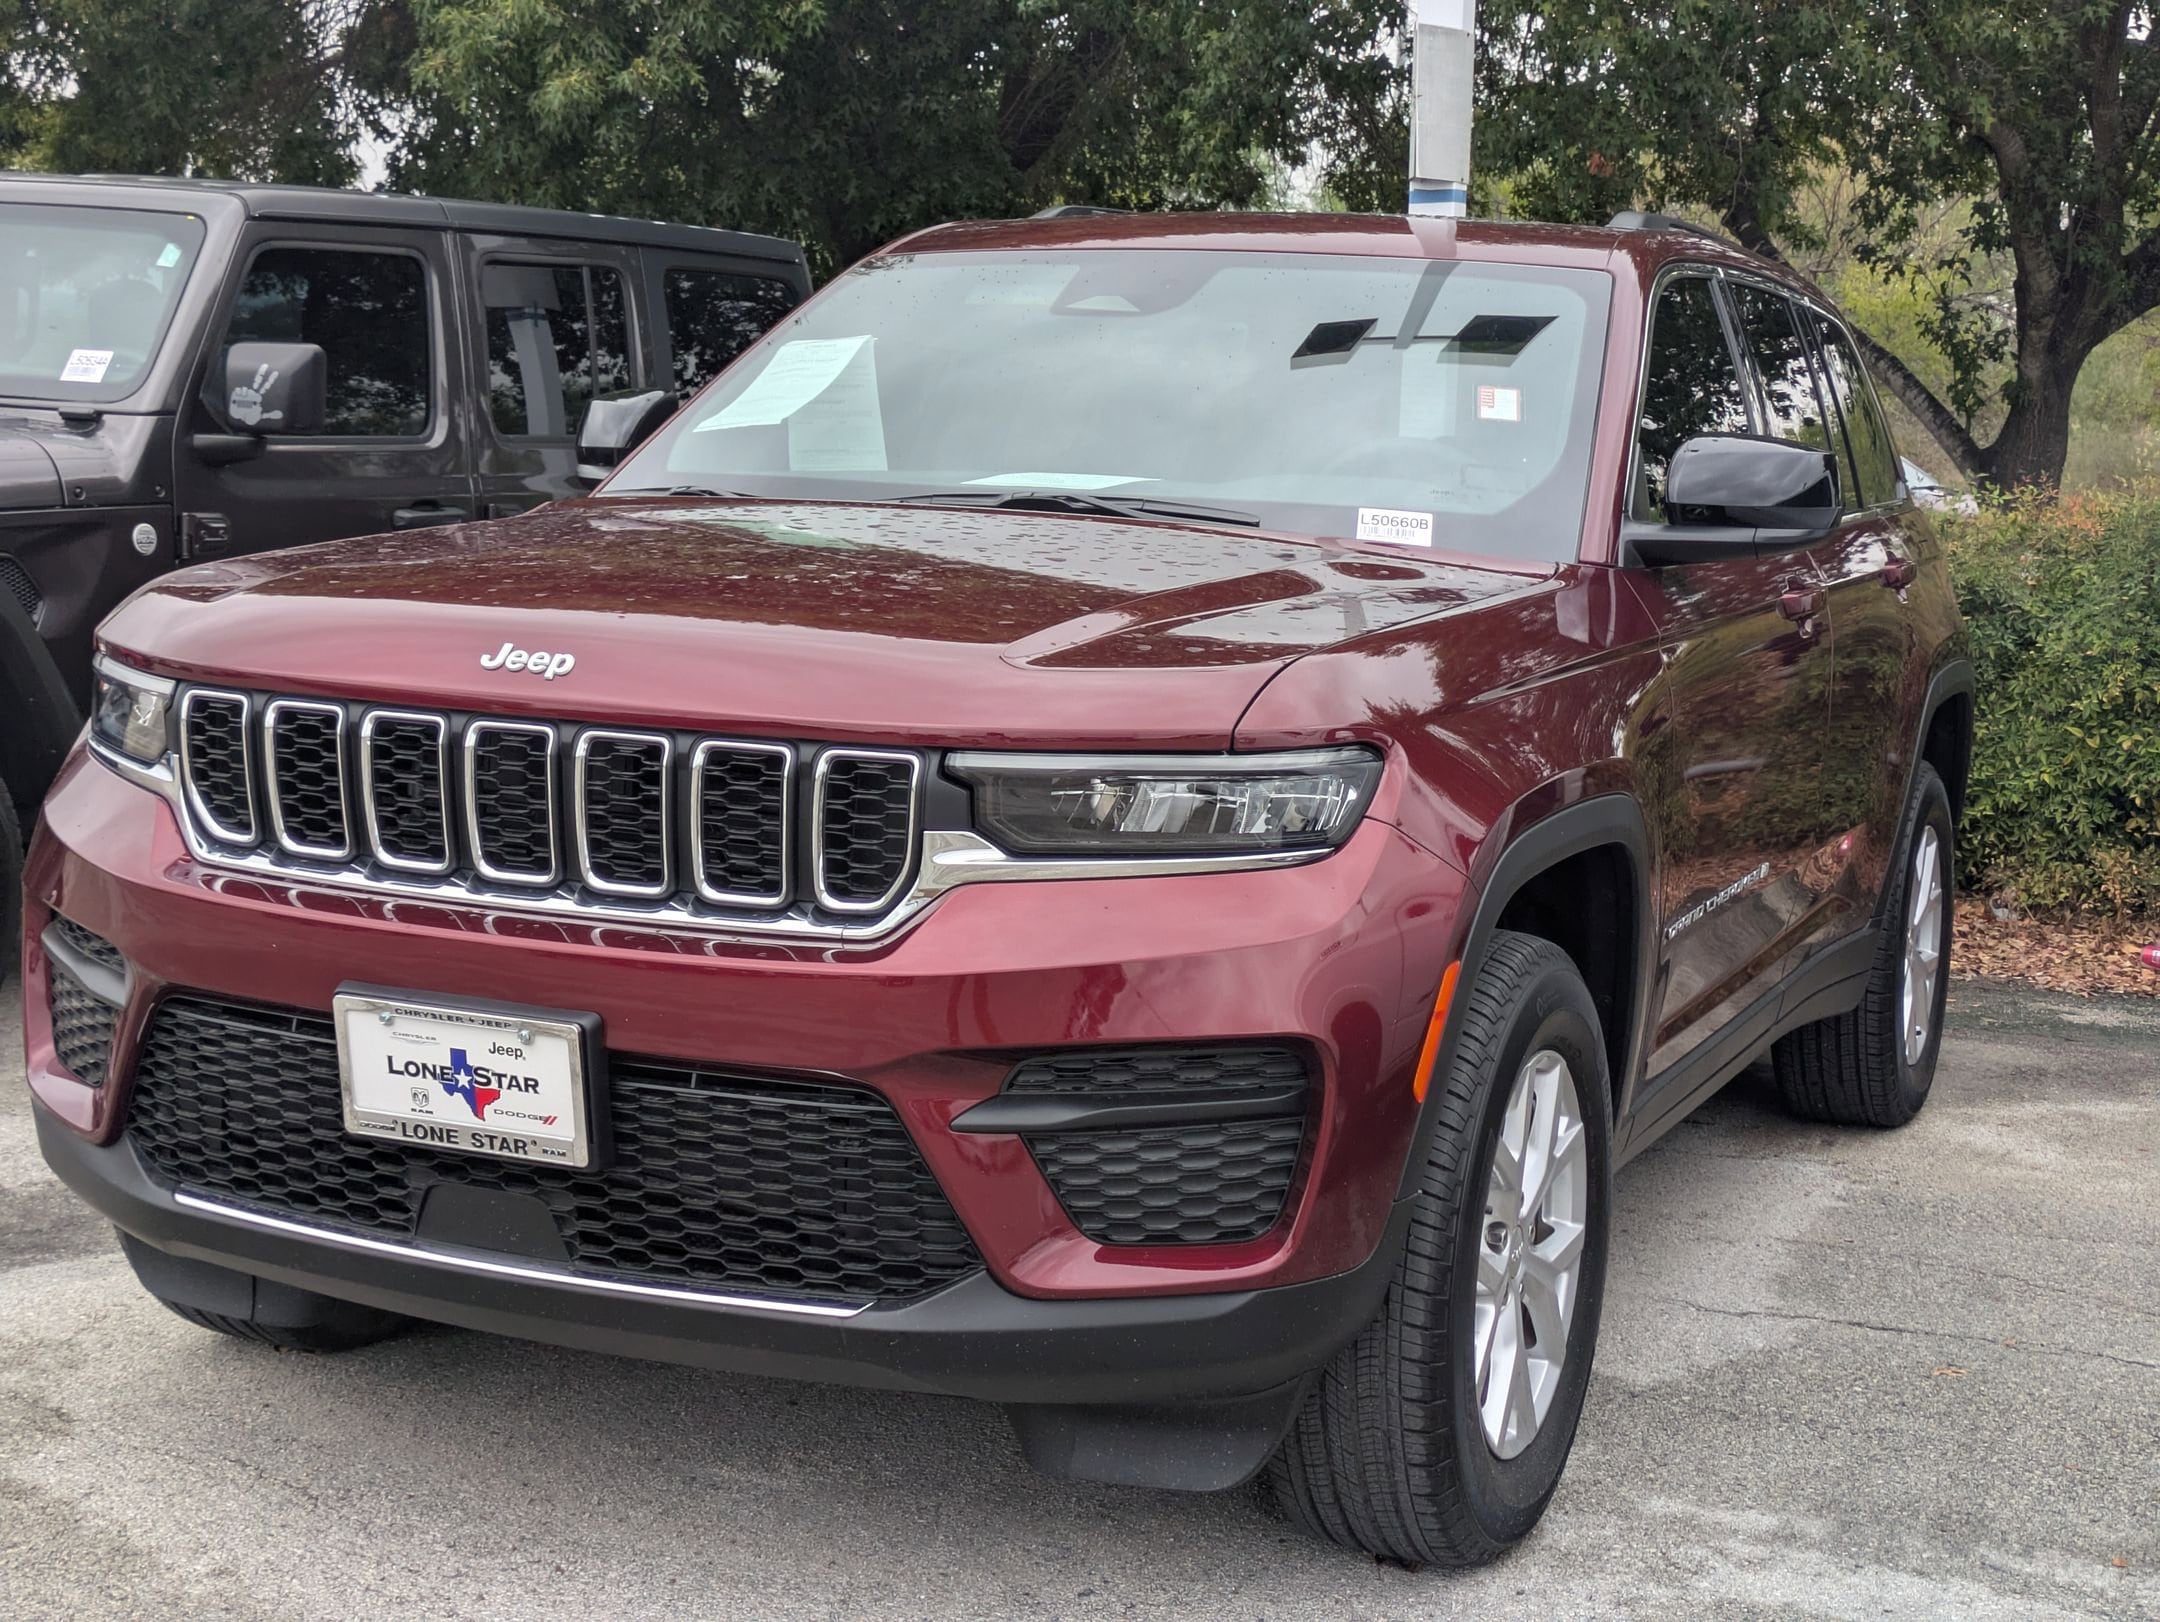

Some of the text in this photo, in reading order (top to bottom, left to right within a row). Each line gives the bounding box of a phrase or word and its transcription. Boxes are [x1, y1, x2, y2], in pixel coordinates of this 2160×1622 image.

[1361, 512, 1429, 530] L50660B
[480, 642, 576, 681] Jeep
[1668, 904, 1705, 941] GRAND
[394, 1007, 512, 1029] CHRYSLER JEEP
[392, 1031, 437, 1041] CHRYSLER
[488, 1042, 524, 1060] Jeep
[387, 1055, 540, 1095] LONE STAR
[410, 1107, 434, 1115] RAM
[493, 1108, 547, 1121] DODGE
[401, 1121, 528, 1155] LONE STAR
[541, 1147, 567, 1158] RAM
